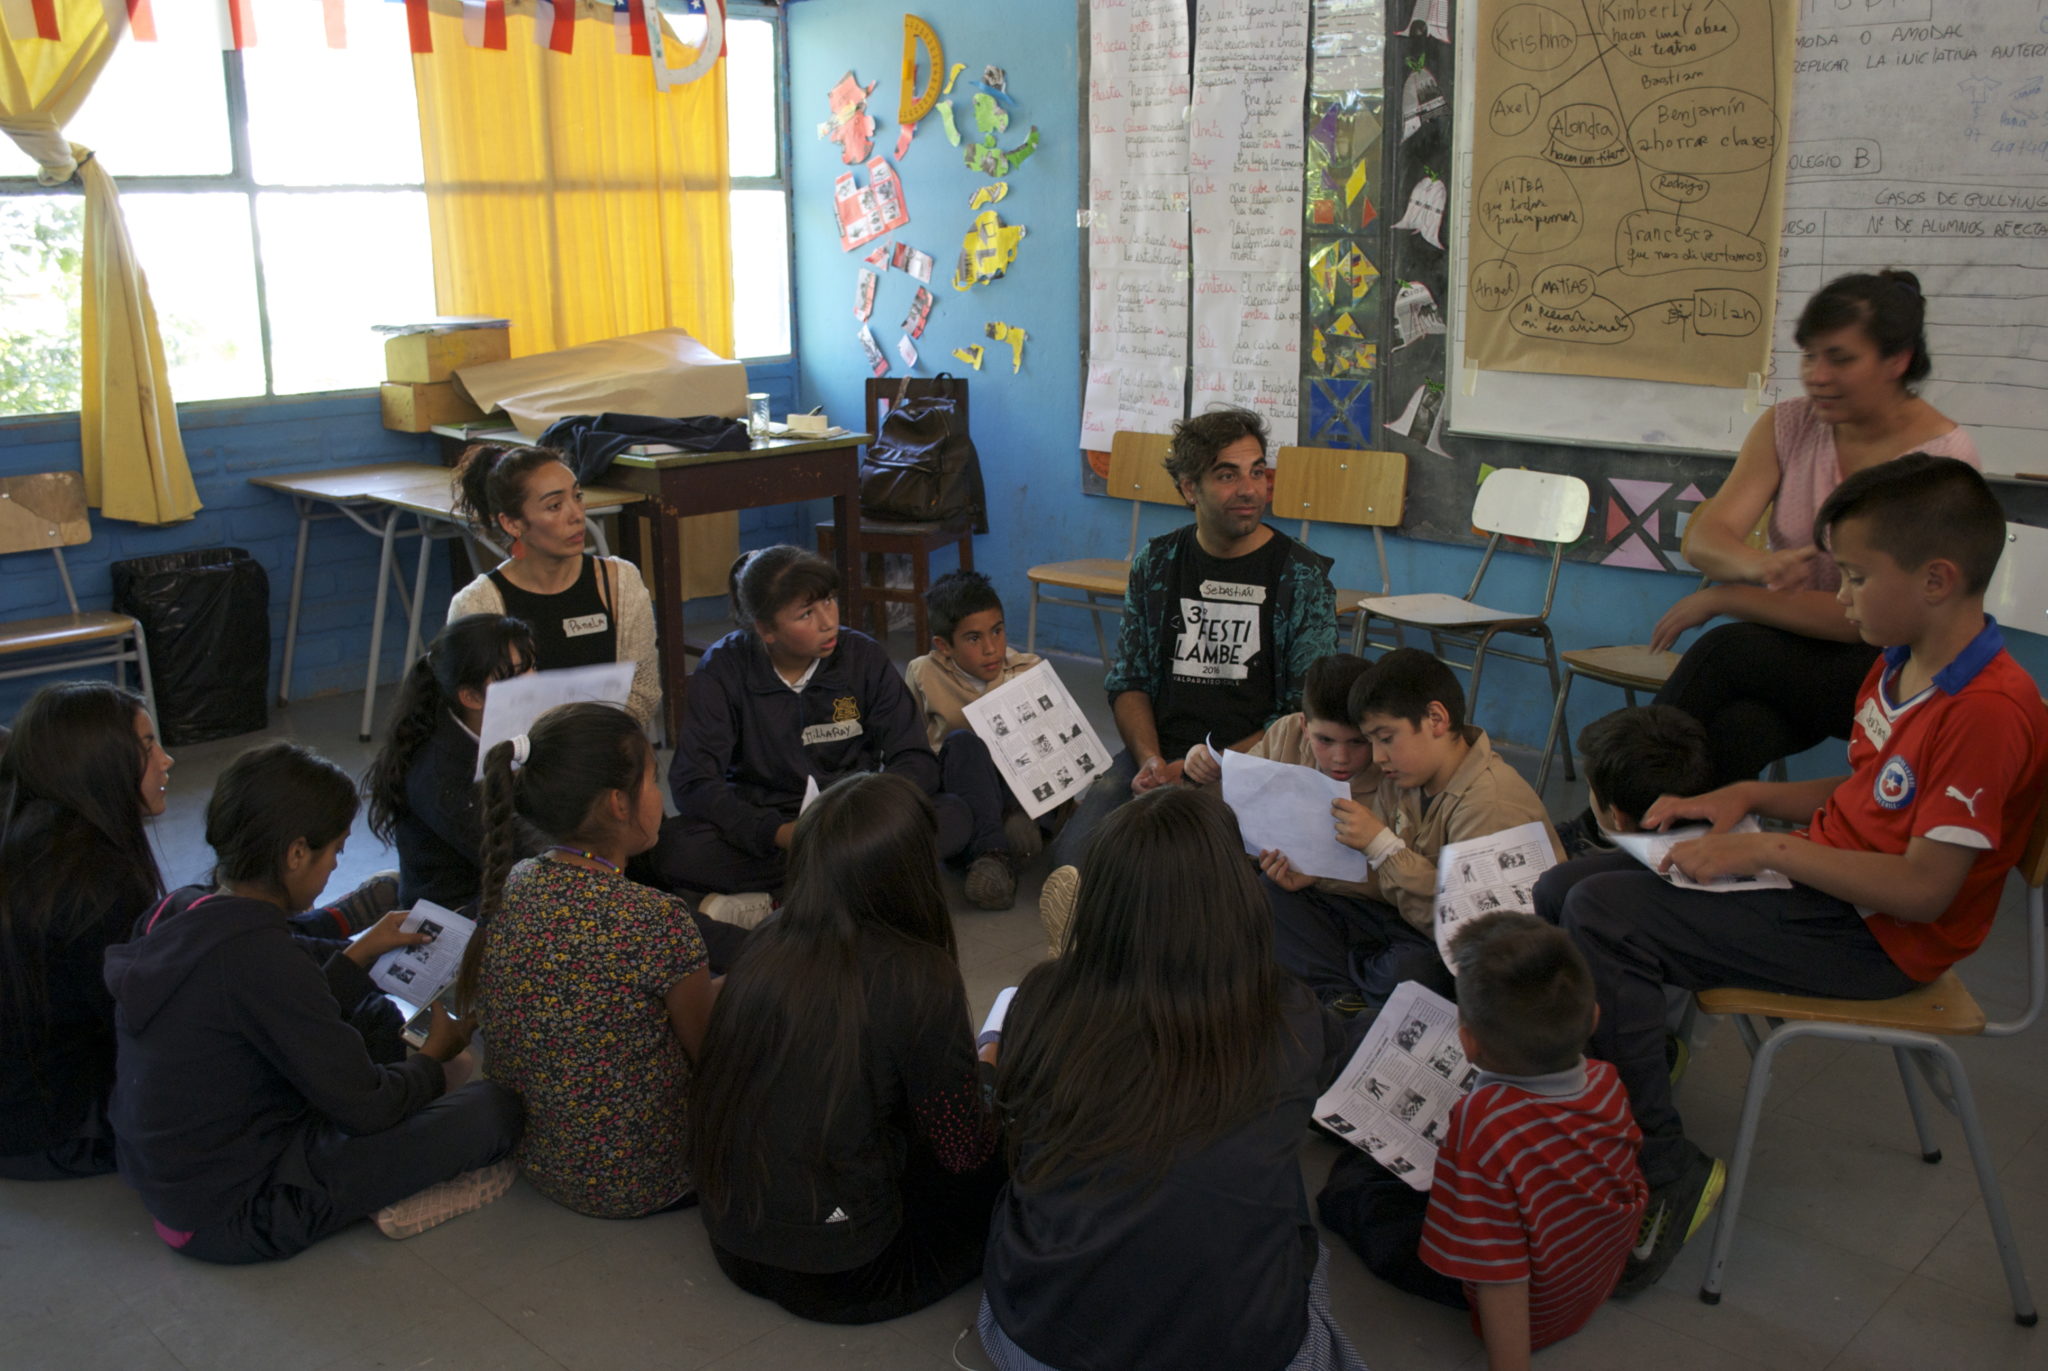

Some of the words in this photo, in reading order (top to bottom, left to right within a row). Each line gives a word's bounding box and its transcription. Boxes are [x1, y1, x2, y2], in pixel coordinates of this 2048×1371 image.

[1495, 12, 1574, 55] Krishna
[1865, 54, 1887, 70] LA
[1495, 92, 1531, 118] Axel
[1788, 152, 1842, 171] OLEGIO
[1854, 146, 1871, 170] B
[1874, 186, 1928, 206] CASOS
[1937, 190, 1960, 206] DE
[1896, 216, 1914, 235] DE
[1920, 218, 1986, 236] ALUMNOS
[1699, 296, 1757, 324] Dilan
[1198, 618, 1253, 643] FESTI
[1174, 639, 1243, 665] LAMBE
